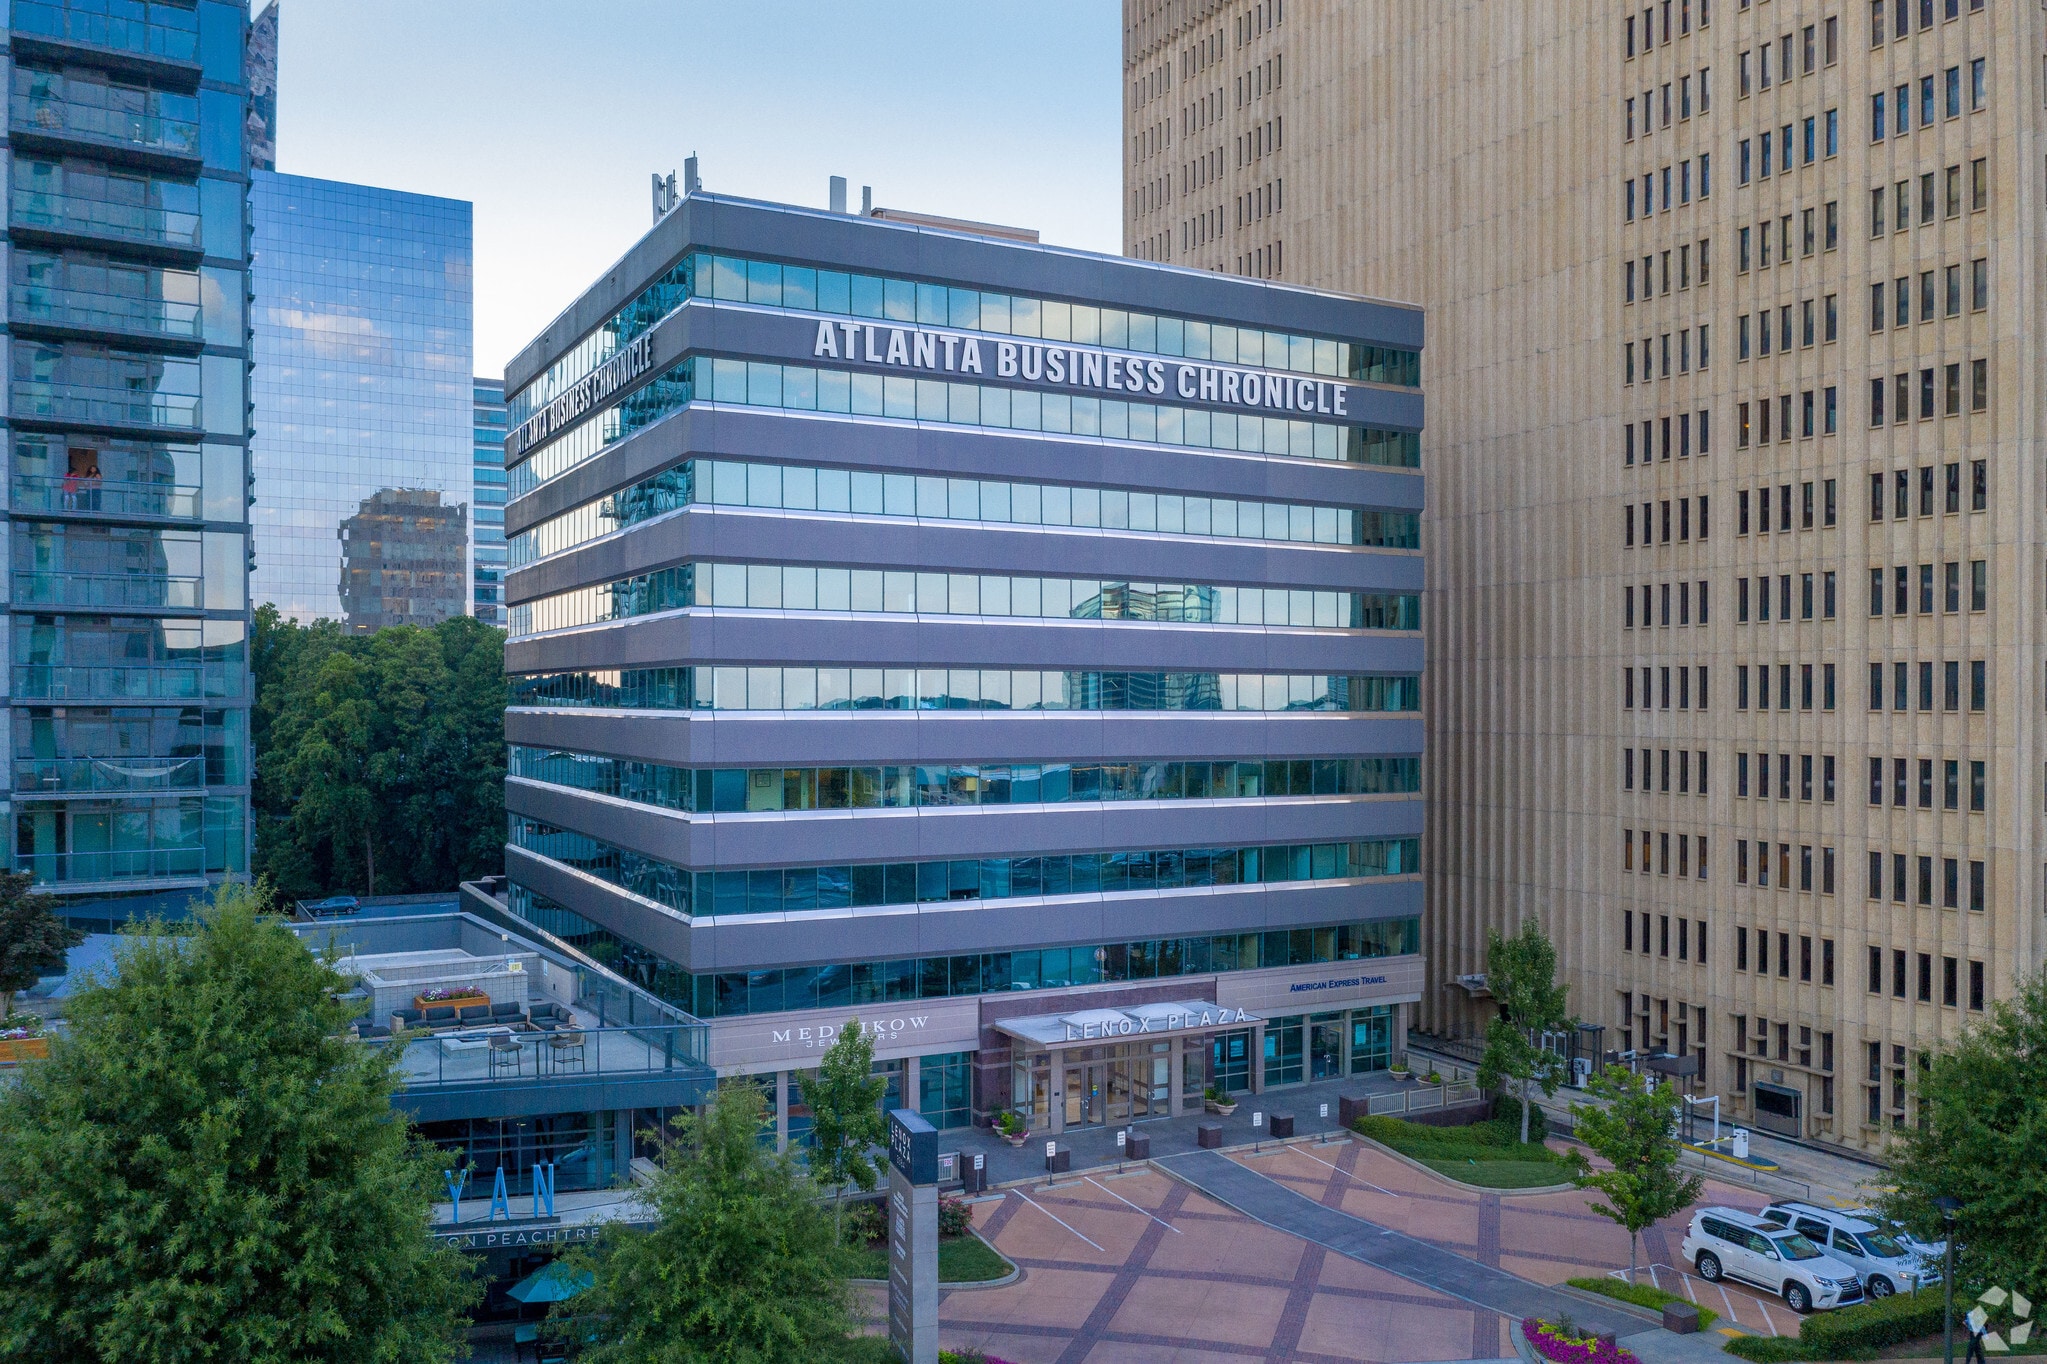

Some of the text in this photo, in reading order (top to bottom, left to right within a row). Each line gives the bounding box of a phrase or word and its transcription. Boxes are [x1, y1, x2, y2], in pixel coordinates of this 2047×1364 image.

[814, 320, 1349, 417] ATLANTA BUSINESS CHRONICLE
[517, 333, 654, 455] ATLANTA BUSINESS CHRONICLE
[1290, 975, 1388, 993] AMERICAN EXPRESS TRAVEL
[772, 1016, 929, 1043] MEDIKOW
[1065, 1007, 1247, 1041] LENOX PLAZA
[806, 1031, 898, 1048] JEWRS
[487, 1227, 608, 1246] PEACHTRE
